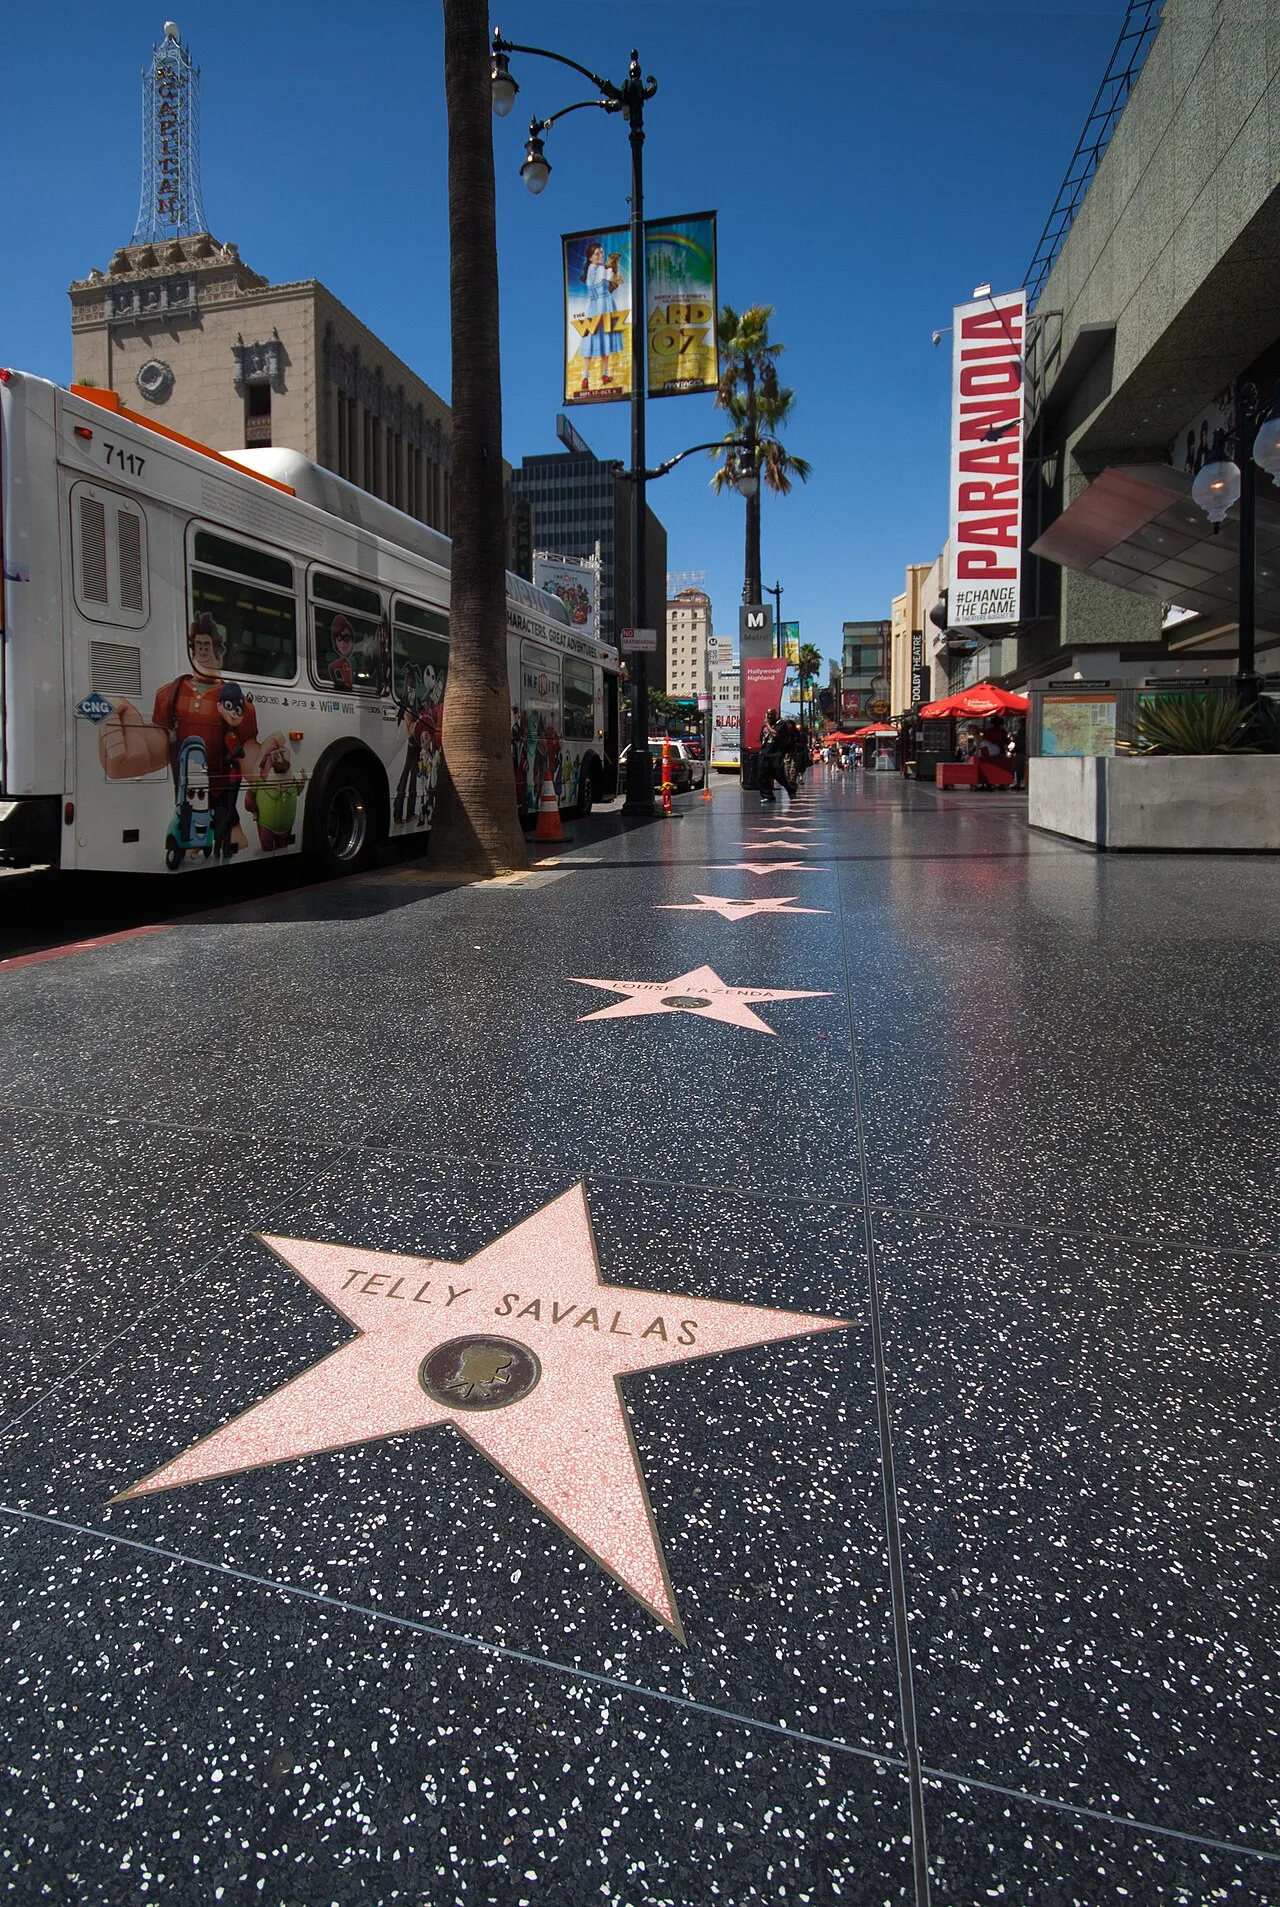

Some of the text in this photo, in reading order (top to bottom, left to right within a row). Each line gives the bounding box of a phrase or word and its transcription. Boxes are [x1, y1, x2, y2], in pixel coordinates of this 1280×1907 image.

[157, 82, 177, 214] CAPITAN
[571, 303, 713, 338] WIZ ARD
[652, 327, 711, 355] OZ
[956, 303, 1023, 580] PARANOIA
[103, 442, 145, 476] 7117
[956, 586, 1016, 603] #CHANGE
[956, 600, 1016, 616] THE GAME
[747, 612, 764, 627] M
[506, 610, 548, 640] HARACTERS.
[549, 629, 567, 648] GREAT
[624, 630, 634, 638] NO
[747, 667, 781, 675] Hollywood/
[912, 634, 922, 701] DOLBY THEATRE
[82, 701, 109, 713] CNG
[291, 699, 307, 708] PS3
[319, 700, 333, 713] Wii
[341, 702, 355, 714] Wii
[612, 982, 775, 998] LOUISE FAZENDA
[340, 1268, 699, 1346] TELLY SAVALAS
